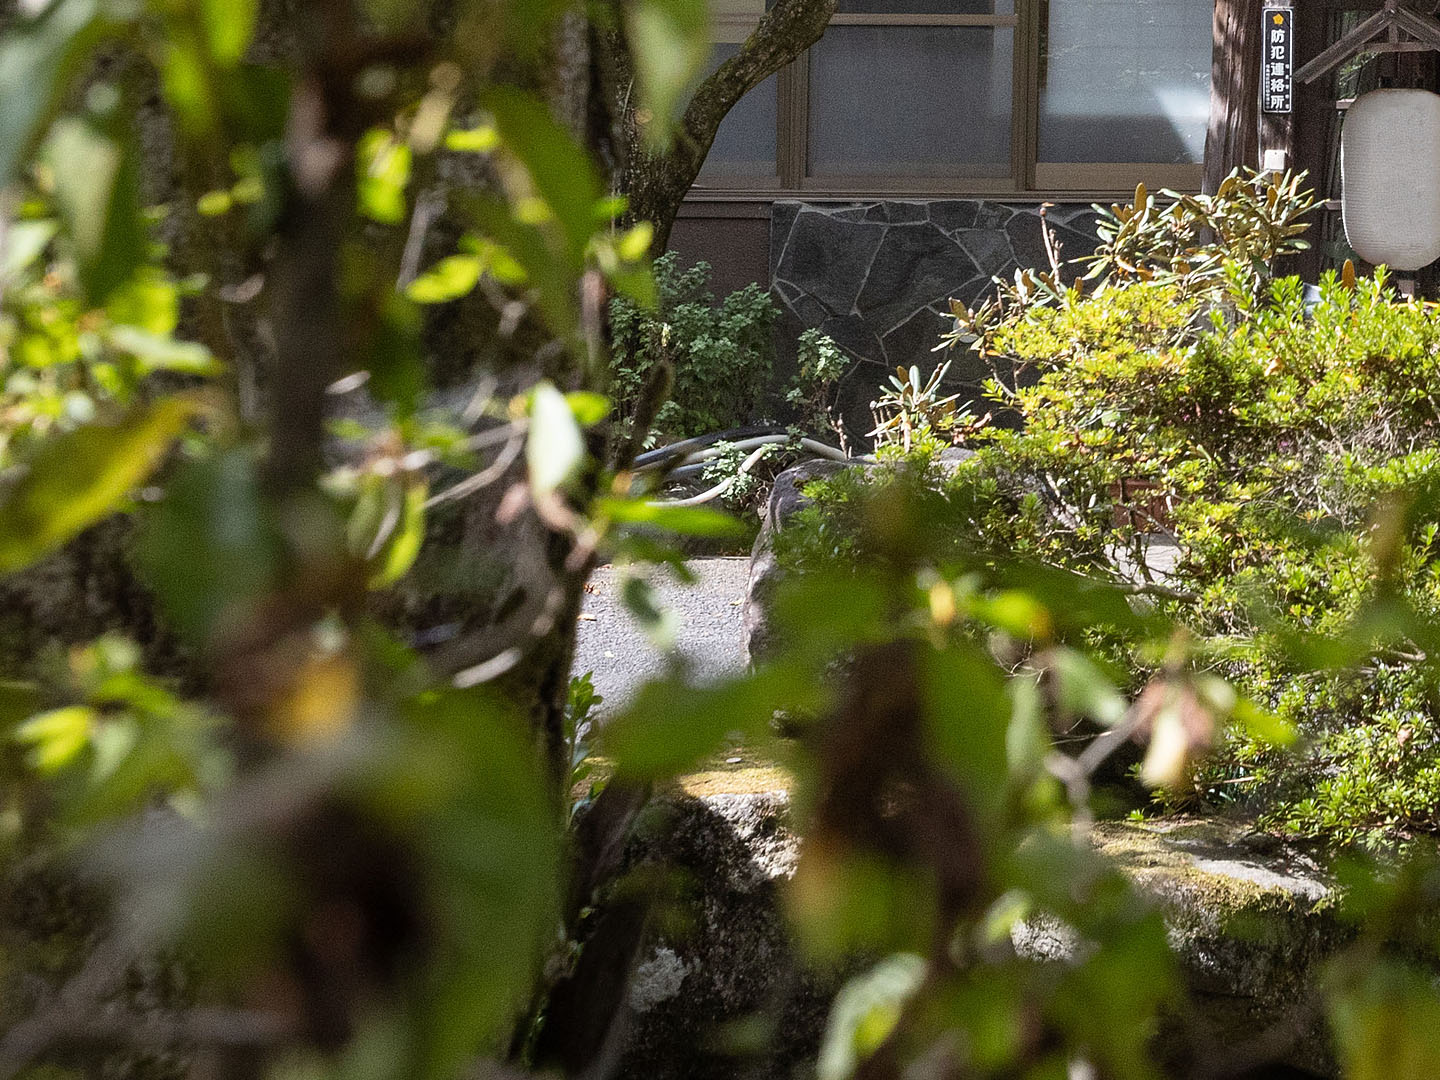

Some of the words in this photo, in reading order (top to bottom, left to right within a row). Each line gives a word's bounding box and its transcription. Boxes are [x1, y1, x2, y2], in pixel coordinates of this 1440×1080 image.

[1270, 29, 1286, 110] 防犯連絡所
